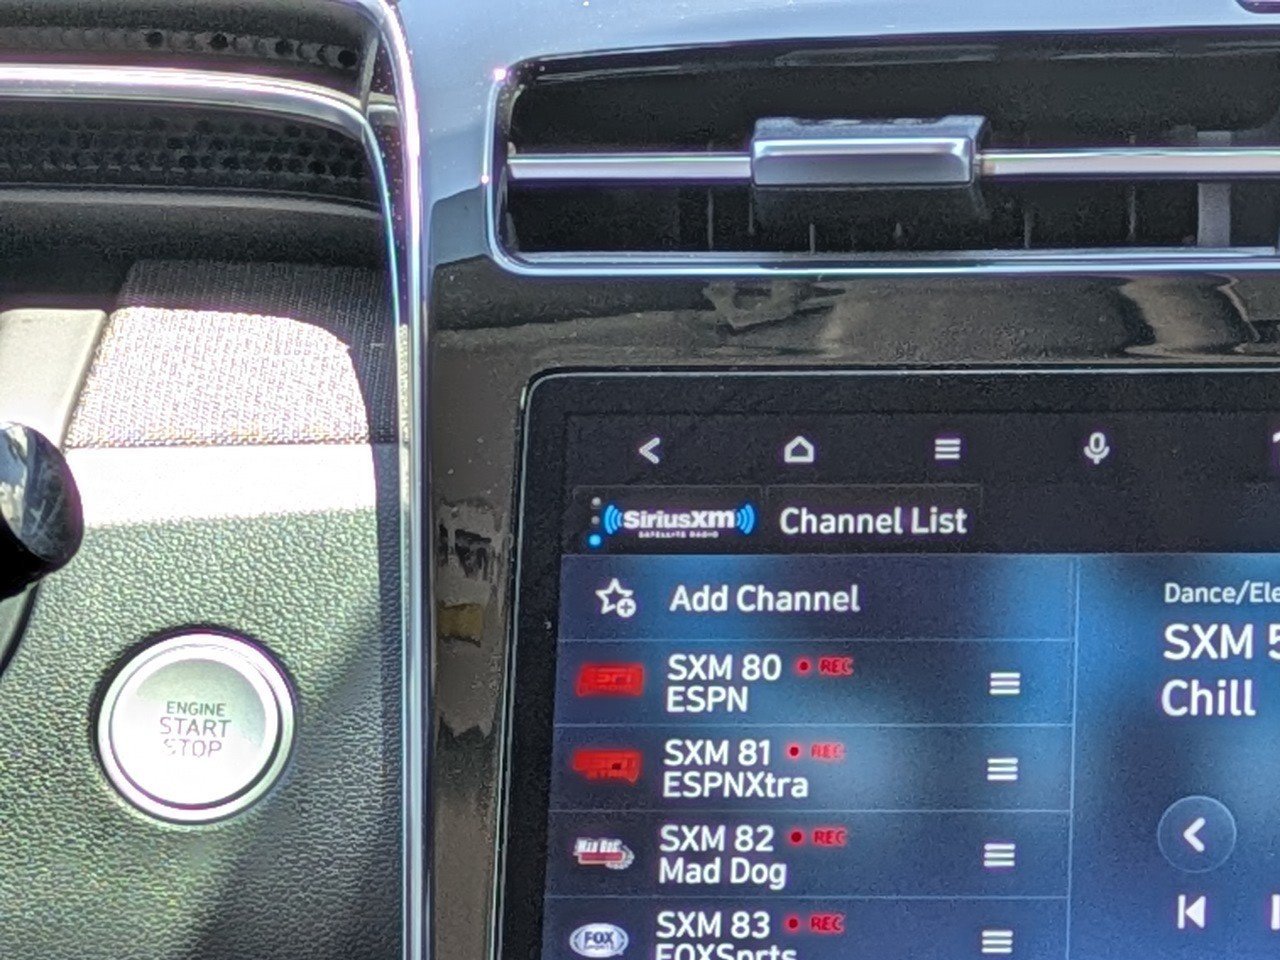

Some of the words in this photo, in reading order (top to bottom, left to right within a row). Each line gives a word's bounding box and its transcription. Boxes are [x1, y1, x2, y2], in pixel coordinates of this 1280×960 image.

[780, 508, 904, 534] Channel
[912, 508, 968, 535] List
[669, 585, 729, 613] Add
[736, 584, 861, 613] Channel
[1163, 624, 1253, 660] SXM
[668, 655, 732, 681] SXM
[741, 654, 782, 680] 80
[818, 658, 853, 675] REC
[166, 701, 226, 717] ENGINE
[666, 685, 749, 713] ESPN
[1161, 680, 1256, 717] Chill
[159, 716, 231, 738] START
[163, 738, 222, 757] STOP
[664, 740, 729, 766] SXM
[738, 739, 770, 765] 81
[663, 772, 809, 798] ESPNXtra
[659, 826, 727, 852] SXM
[734, 826, 774, 851] 82
[814, 830, 846, 846] REC
[659, 858, 721, 884] Mad
[729, 858, 787, 890] Dog
[584, 931, 614, 945] FOX
[655, 911, 723, 938] SXM
[730, 911, 770, 937] 83
[811, 915, 844, 932] REC
